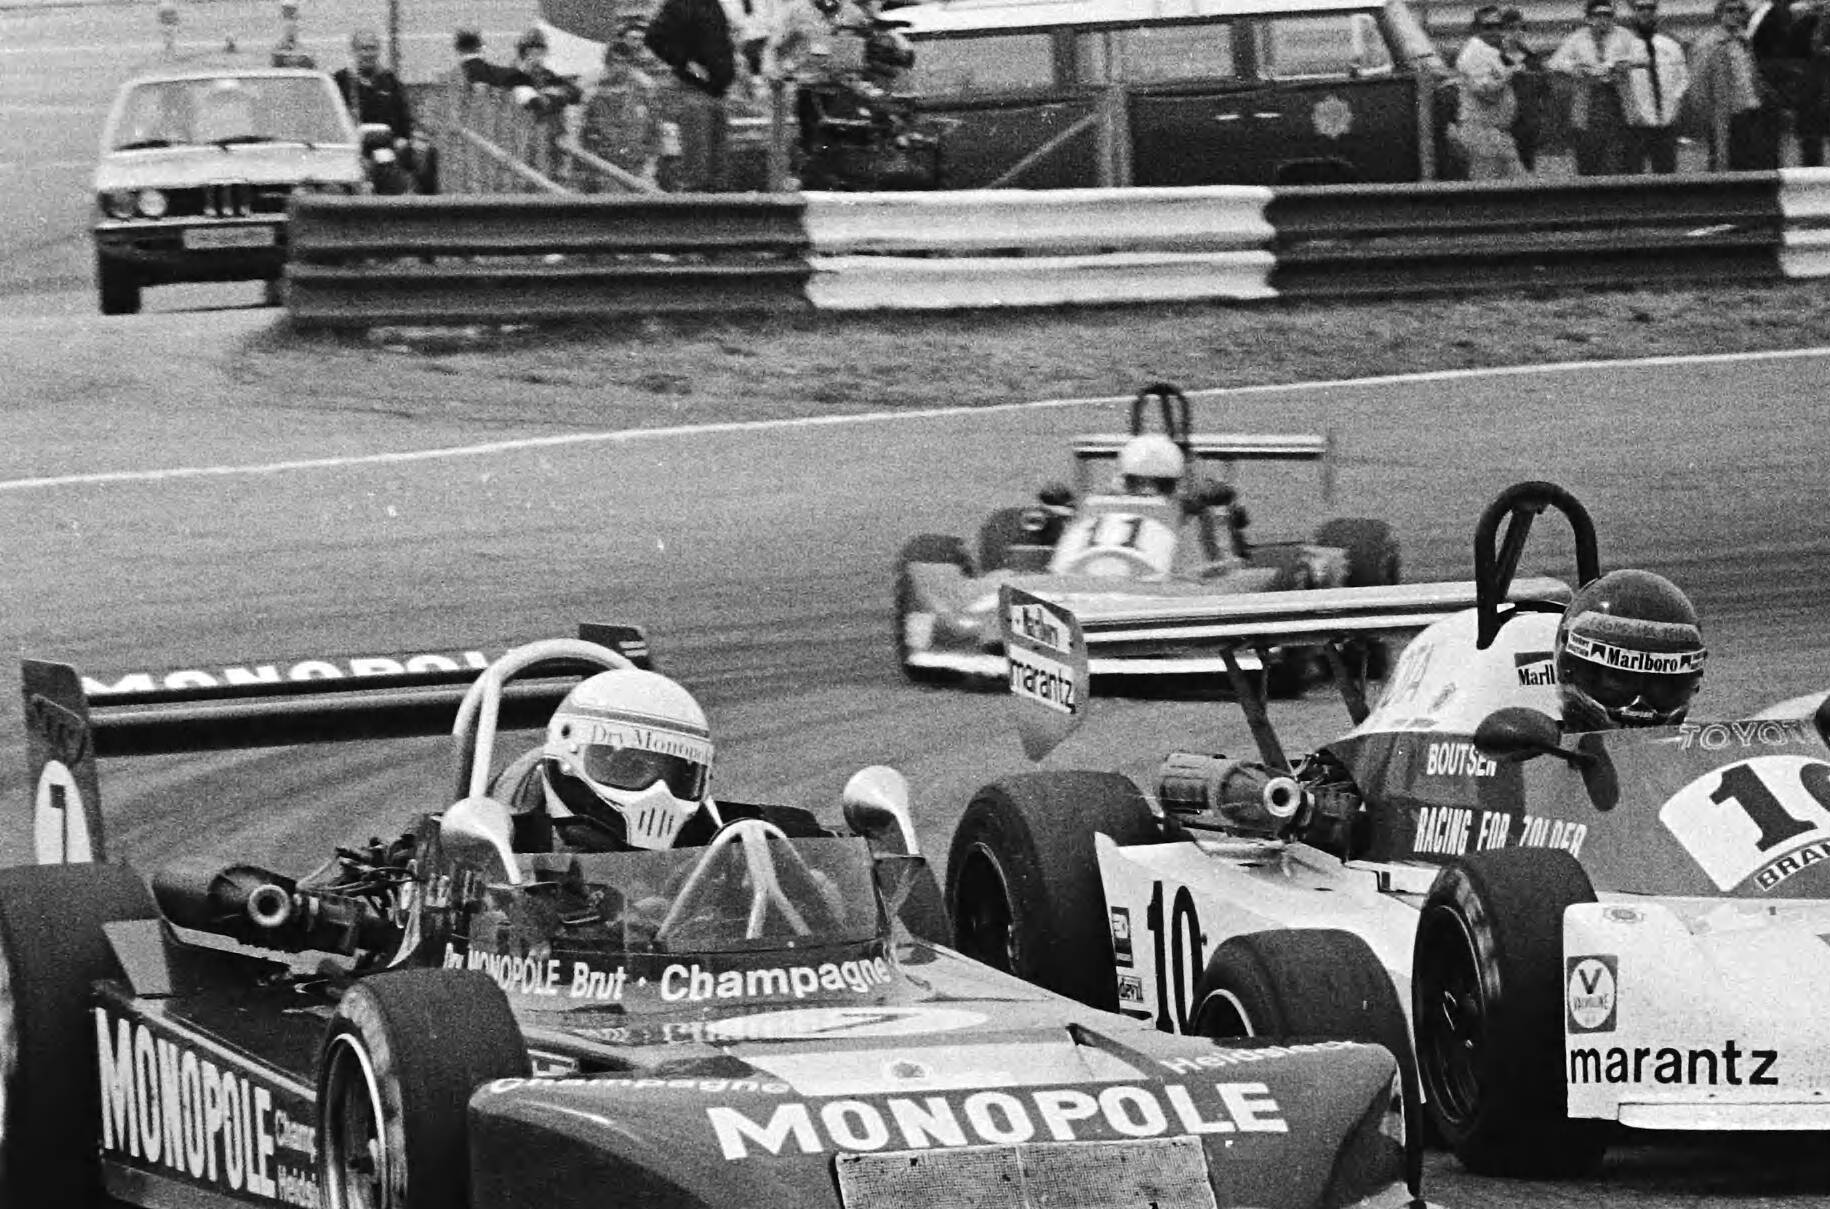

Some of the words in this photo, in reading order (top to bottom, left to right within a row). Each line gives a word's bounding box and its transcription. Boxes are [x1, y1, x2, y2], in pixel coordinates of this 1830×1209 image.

[1010, 658, 1077, 714] marantz
[1607, 648, 1679, 672] Marlboro
[1413, 805, 1473, 856] RACING
[1476, 810, 1511, 851] FOR
[569, 961, 627, 1000] Brut
[660, 956, 892, 1001] Champagne
[1147, 880, 1206, 1038] 10
[1570, 1039, 1779, 1085] marantz
[95, 1007, 277, 1200] MONOPOLE
[706, 1082, 1290, 1161] MONOPOLE
